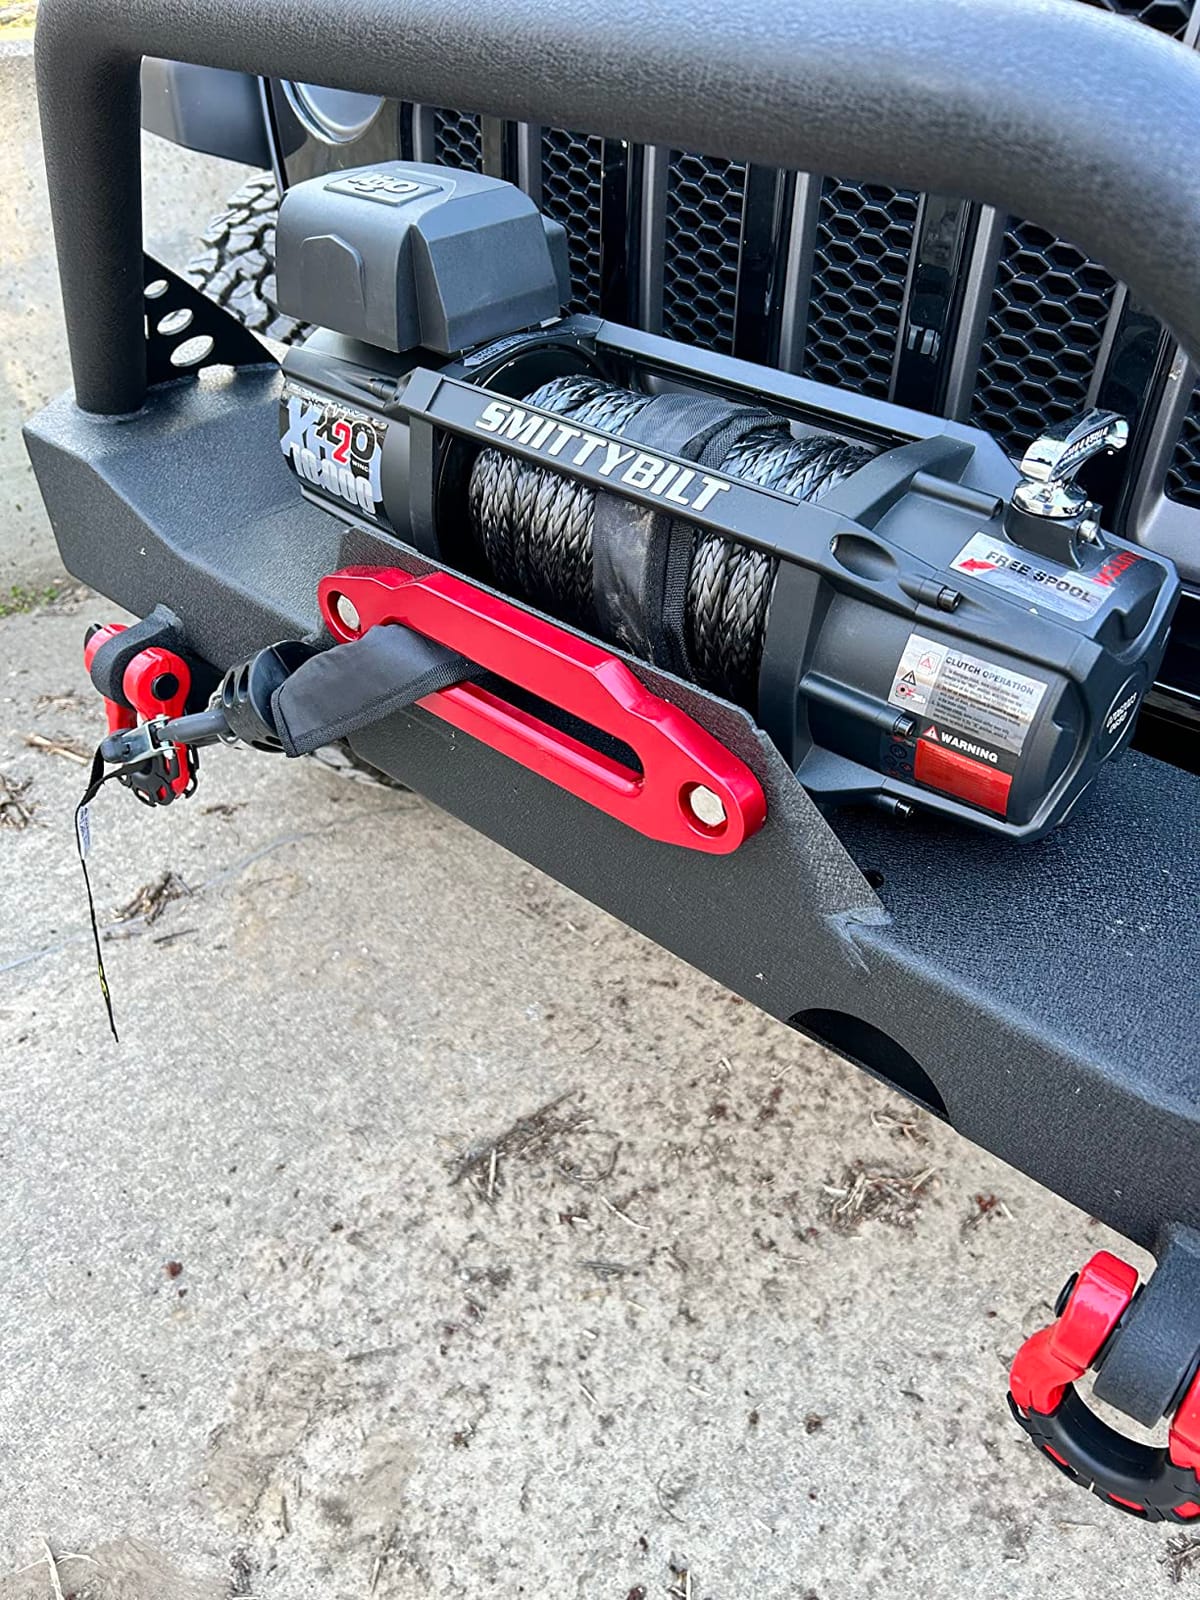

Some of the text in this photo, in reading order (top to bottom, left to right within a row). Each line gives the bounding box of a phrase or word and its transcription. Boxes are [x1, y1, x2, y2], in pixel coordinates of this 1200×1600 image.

[475, 401, 731, 511] SMITTYBILT
[985, 550, 1091, 604] FREE SPOOL
[945, 656, 1035, 696] CLUTCH OPERATION
[941, 732, 998, 764] WARNING
